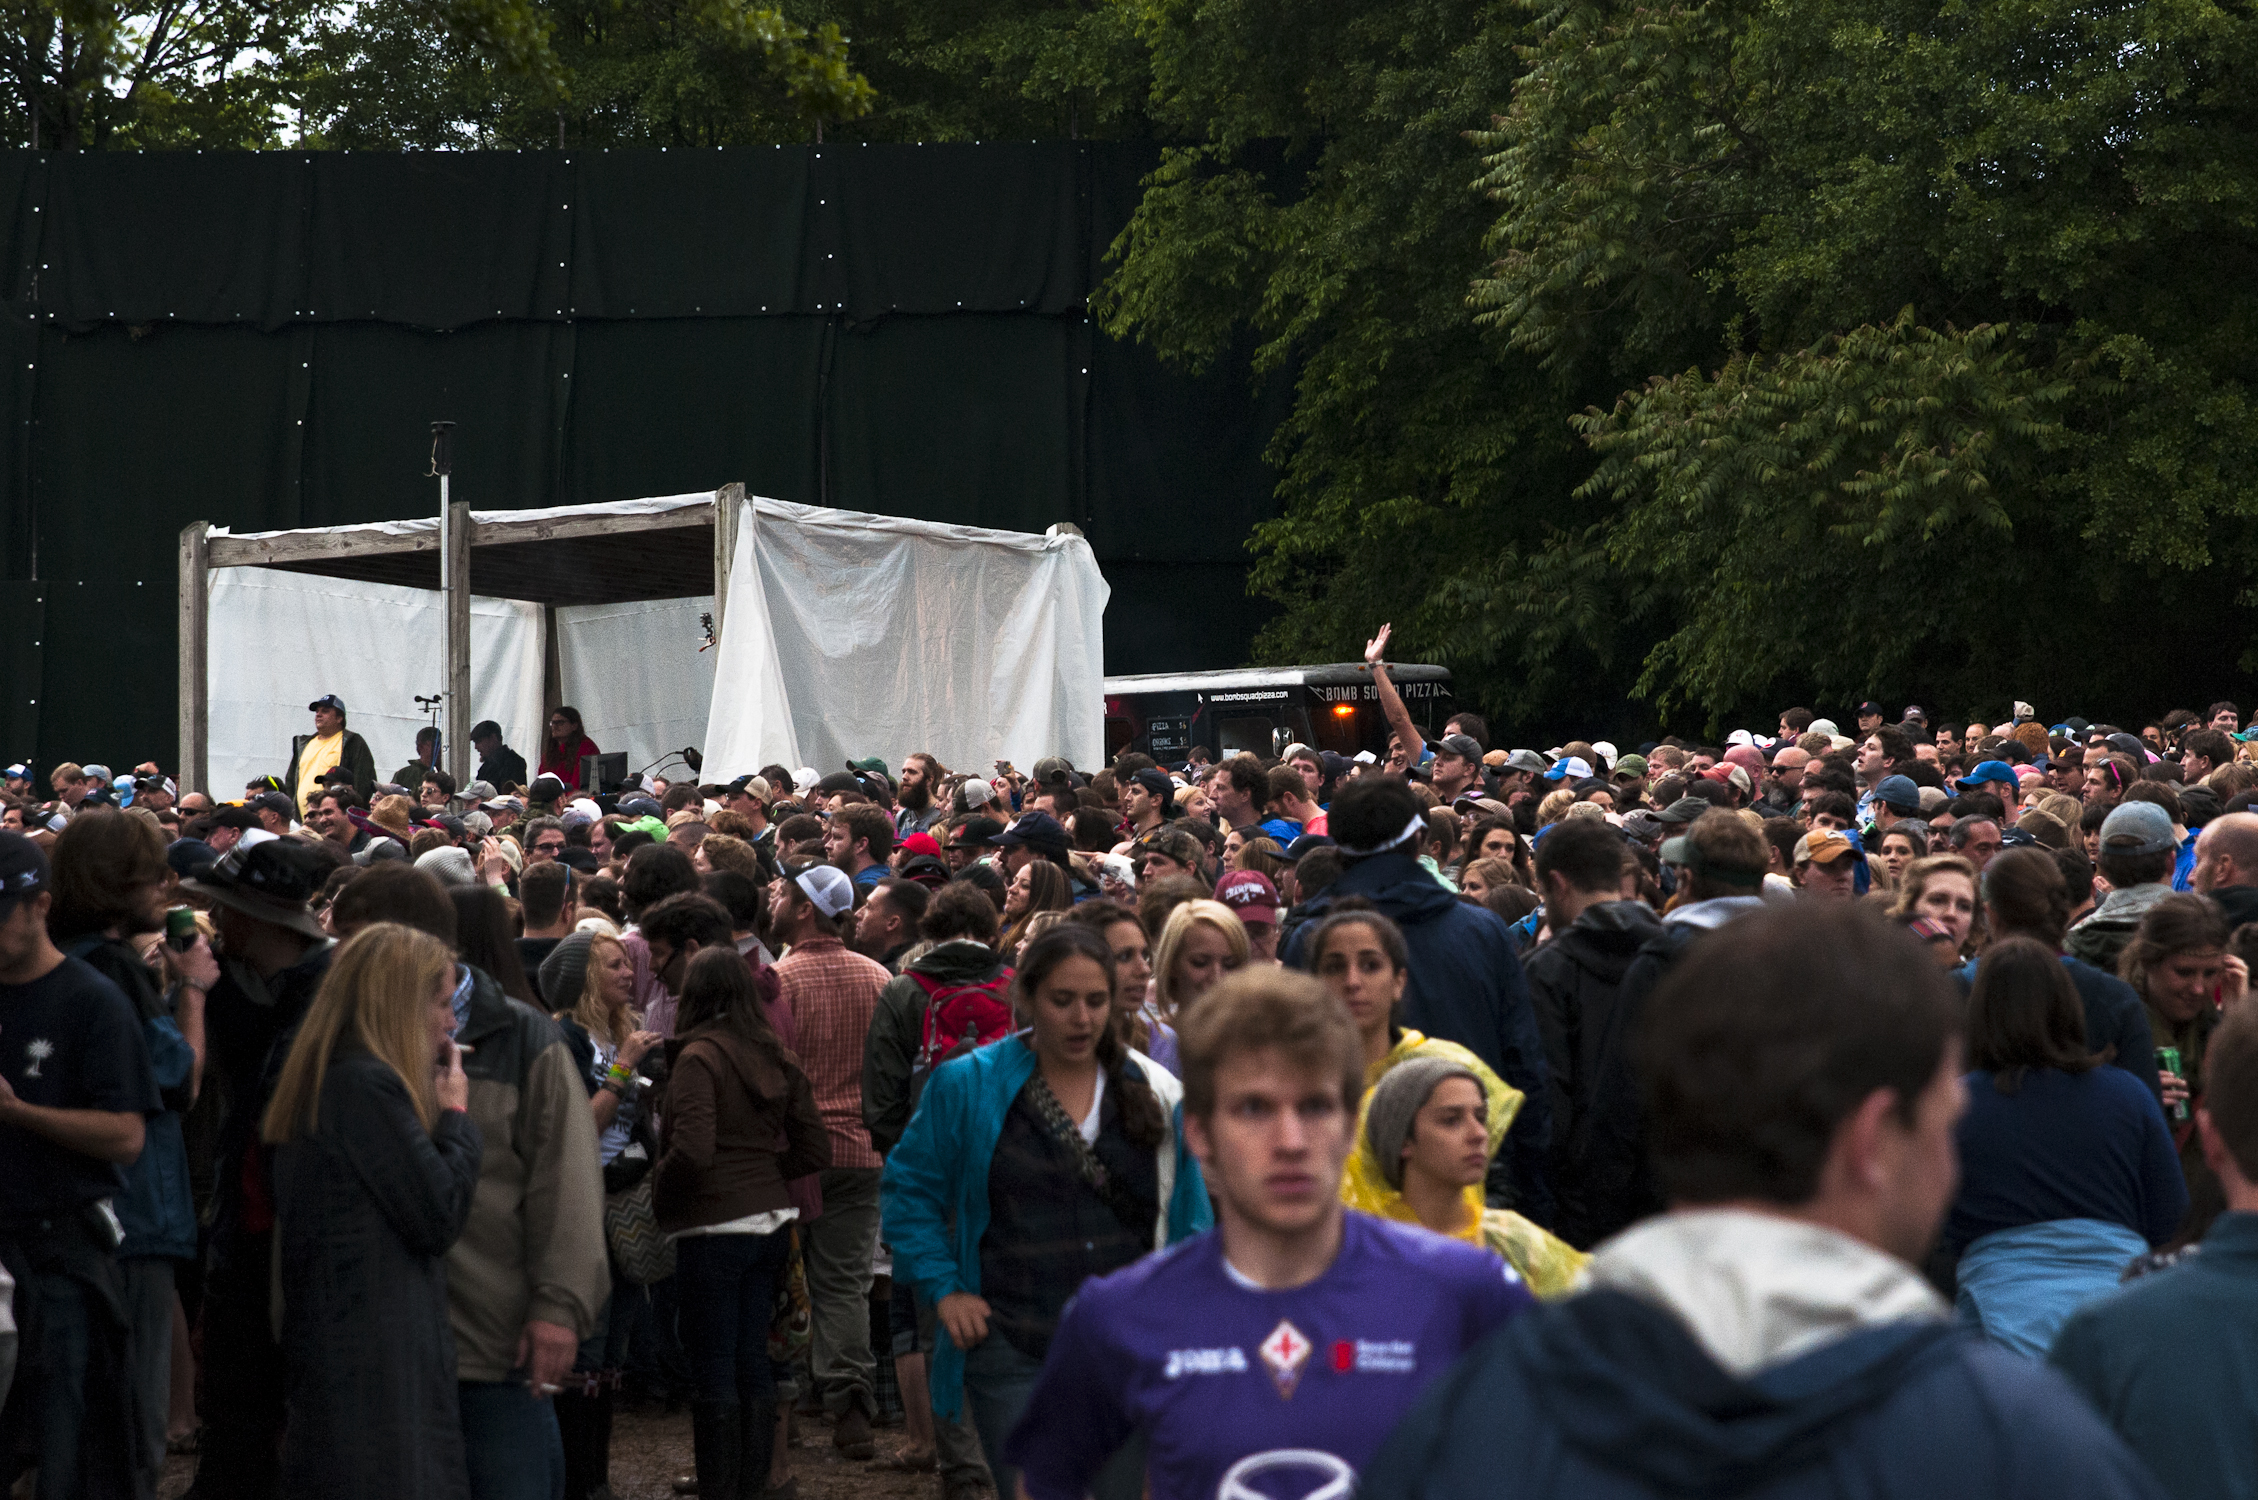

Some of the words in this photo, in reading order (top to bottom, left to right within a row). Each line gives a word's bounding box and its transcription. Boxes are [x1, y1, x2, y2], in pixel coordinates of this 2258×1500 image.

[1210, 691, 1289, 702] www.bombsquadpizza.com
[1326, 686, 1358, 701] BOMB
[1364, 684, 1400, 700] SQD
[1405, 683, 1440, 698] PIZZA
[1225, 883, 1265, 900] CHAMPIONS
